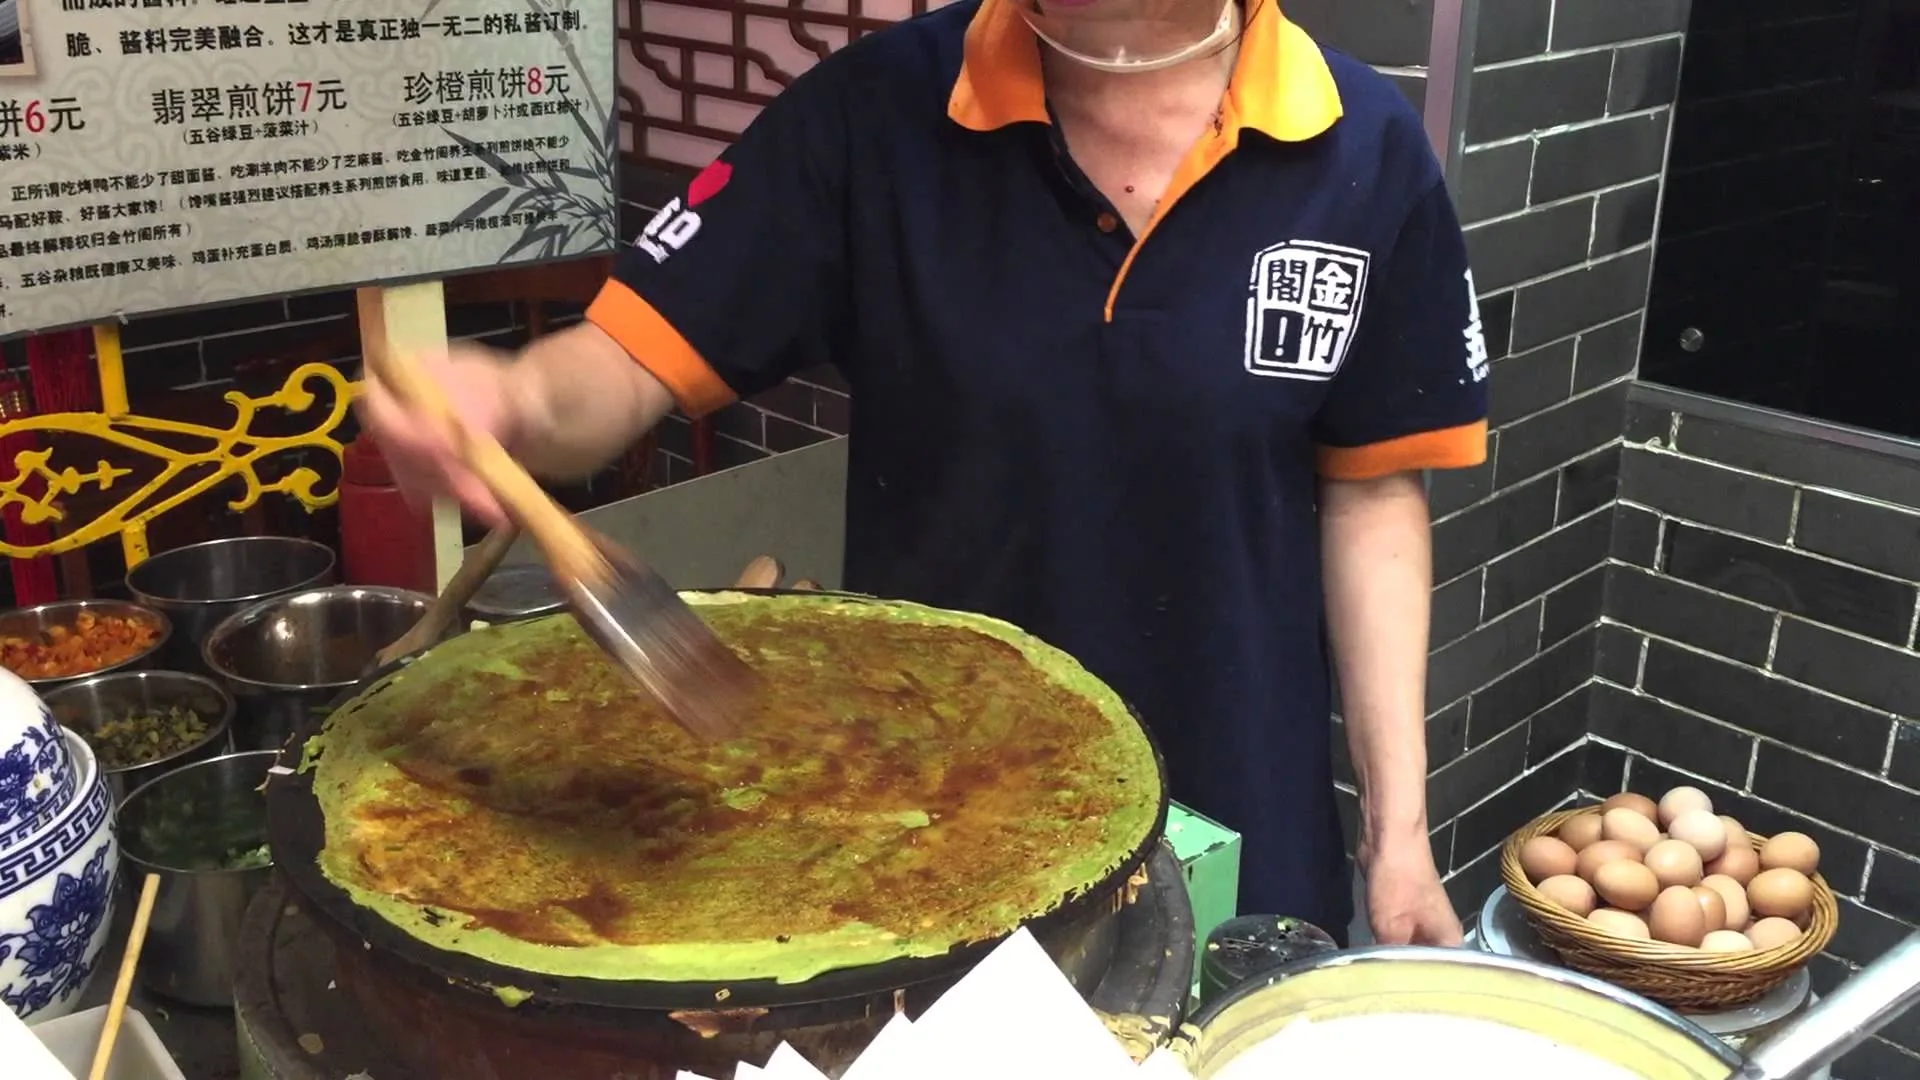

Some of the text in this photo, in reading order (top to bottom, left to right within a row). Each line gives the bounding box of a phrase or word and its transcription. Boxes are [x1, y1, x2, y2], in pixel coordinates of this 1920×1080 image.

[152, 80, 347, 125] 翡翠煎饼7元
[403, 65, 570, 105] 珍橙煎饼8元
